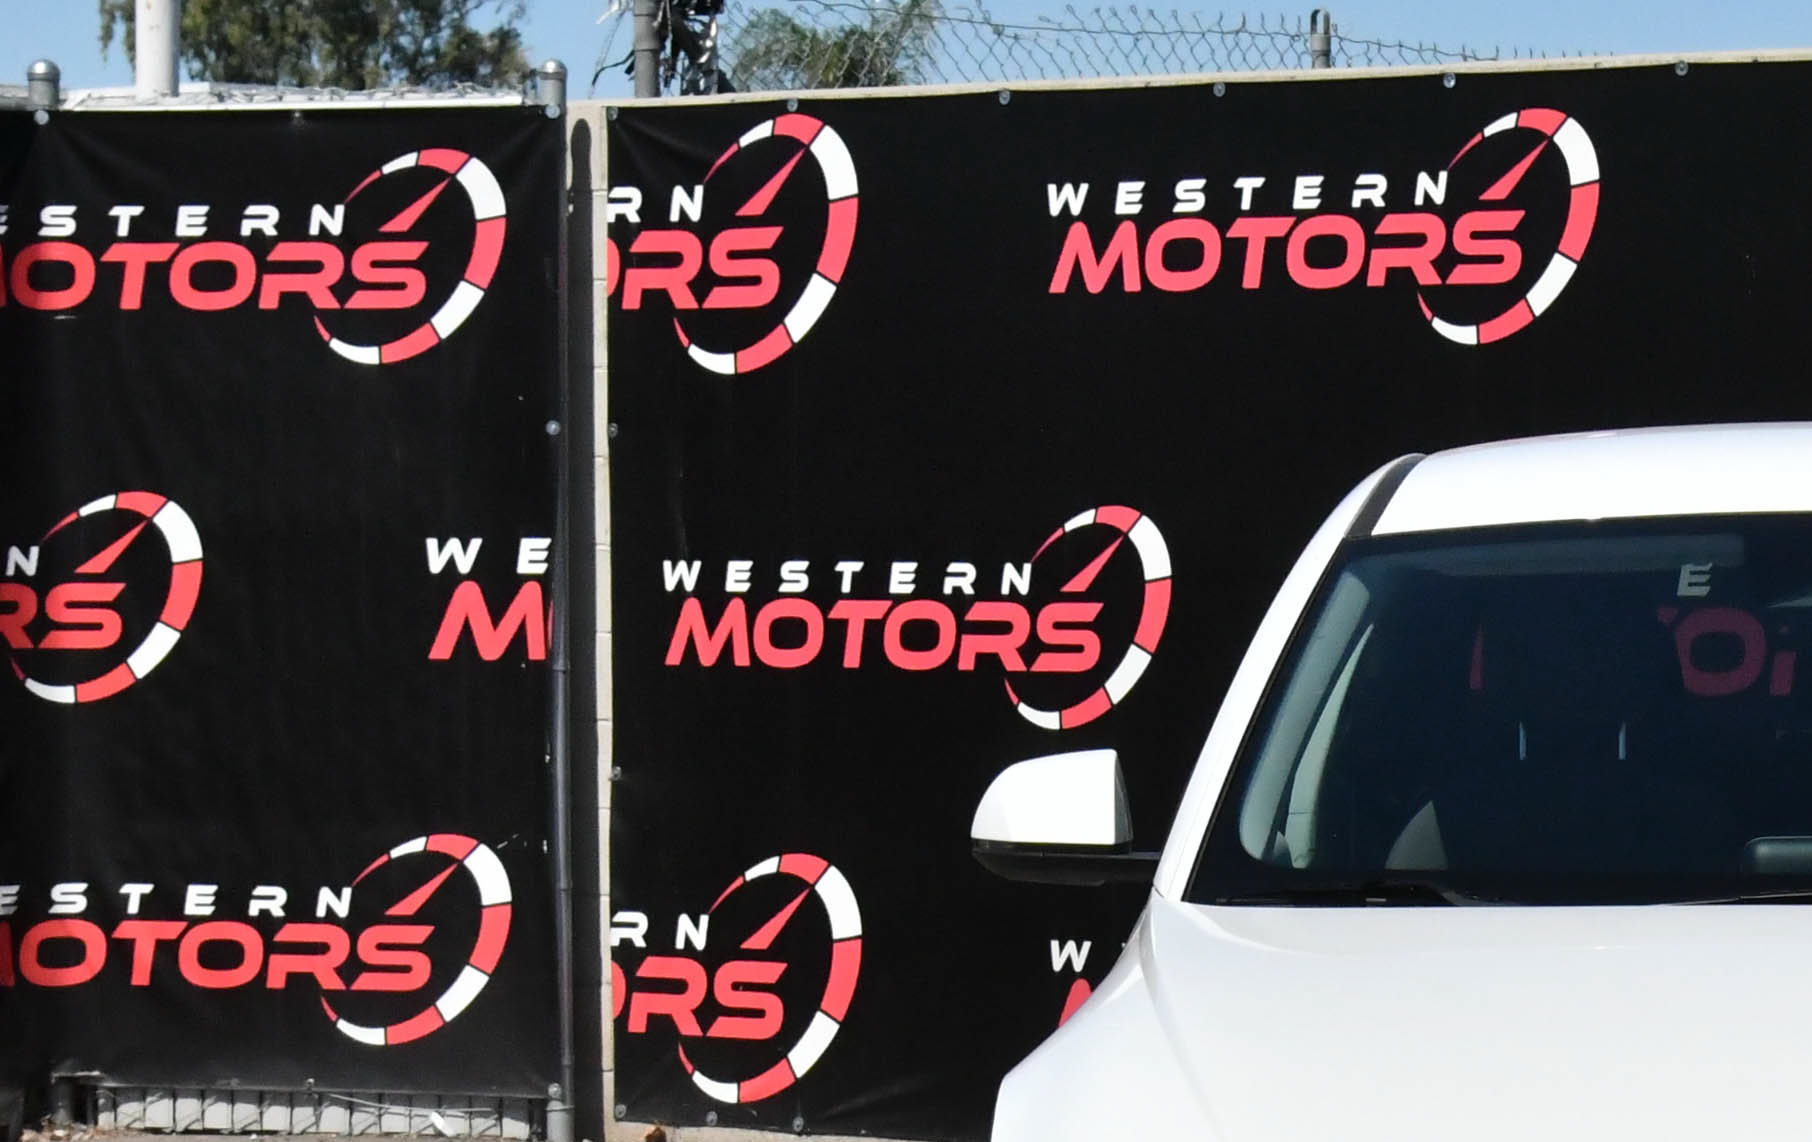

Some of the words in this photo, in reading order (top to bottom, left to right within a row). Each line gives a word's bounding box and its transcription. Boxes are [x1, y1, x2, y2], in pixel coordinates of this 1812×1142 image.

[0, 204, 345, 237] STERN
[1048, 171, 1448, 216] WESTERN
[0, 240, 429, 312] OTORS
[1048, 209, 1526, 294] MOTORS
[663, 560, 1032, 595] WESTERN
[664, 596, 1104, 673] MOTORS
[0, 918, 435, 992] OTORS
